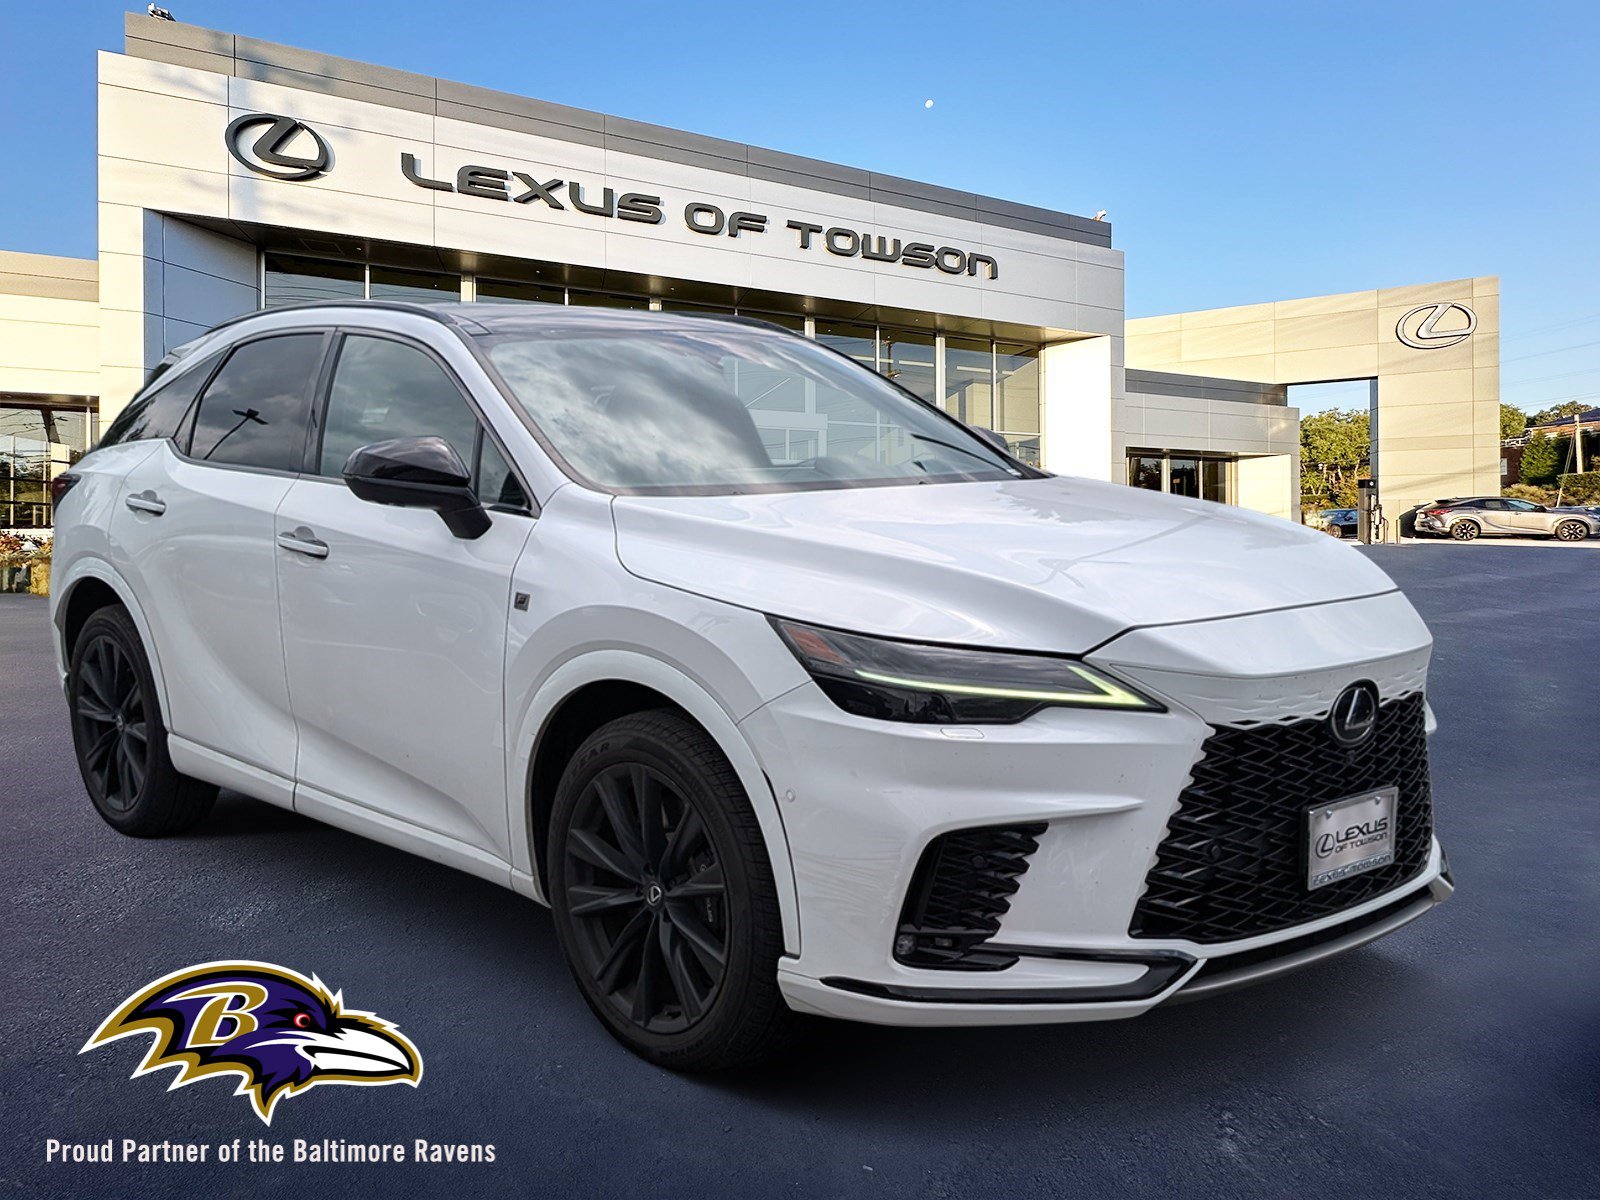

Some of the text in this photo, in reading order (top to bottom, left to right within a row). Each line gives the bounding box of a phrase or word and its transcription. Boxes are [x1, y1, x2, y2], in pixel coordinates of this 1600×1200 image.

[401, 152, 998, 280] LEXUS OF TOWSON
[1335, 832, 1388, 854] OF TOWSON
[1336, 817, 1388, 843] LEXUS
